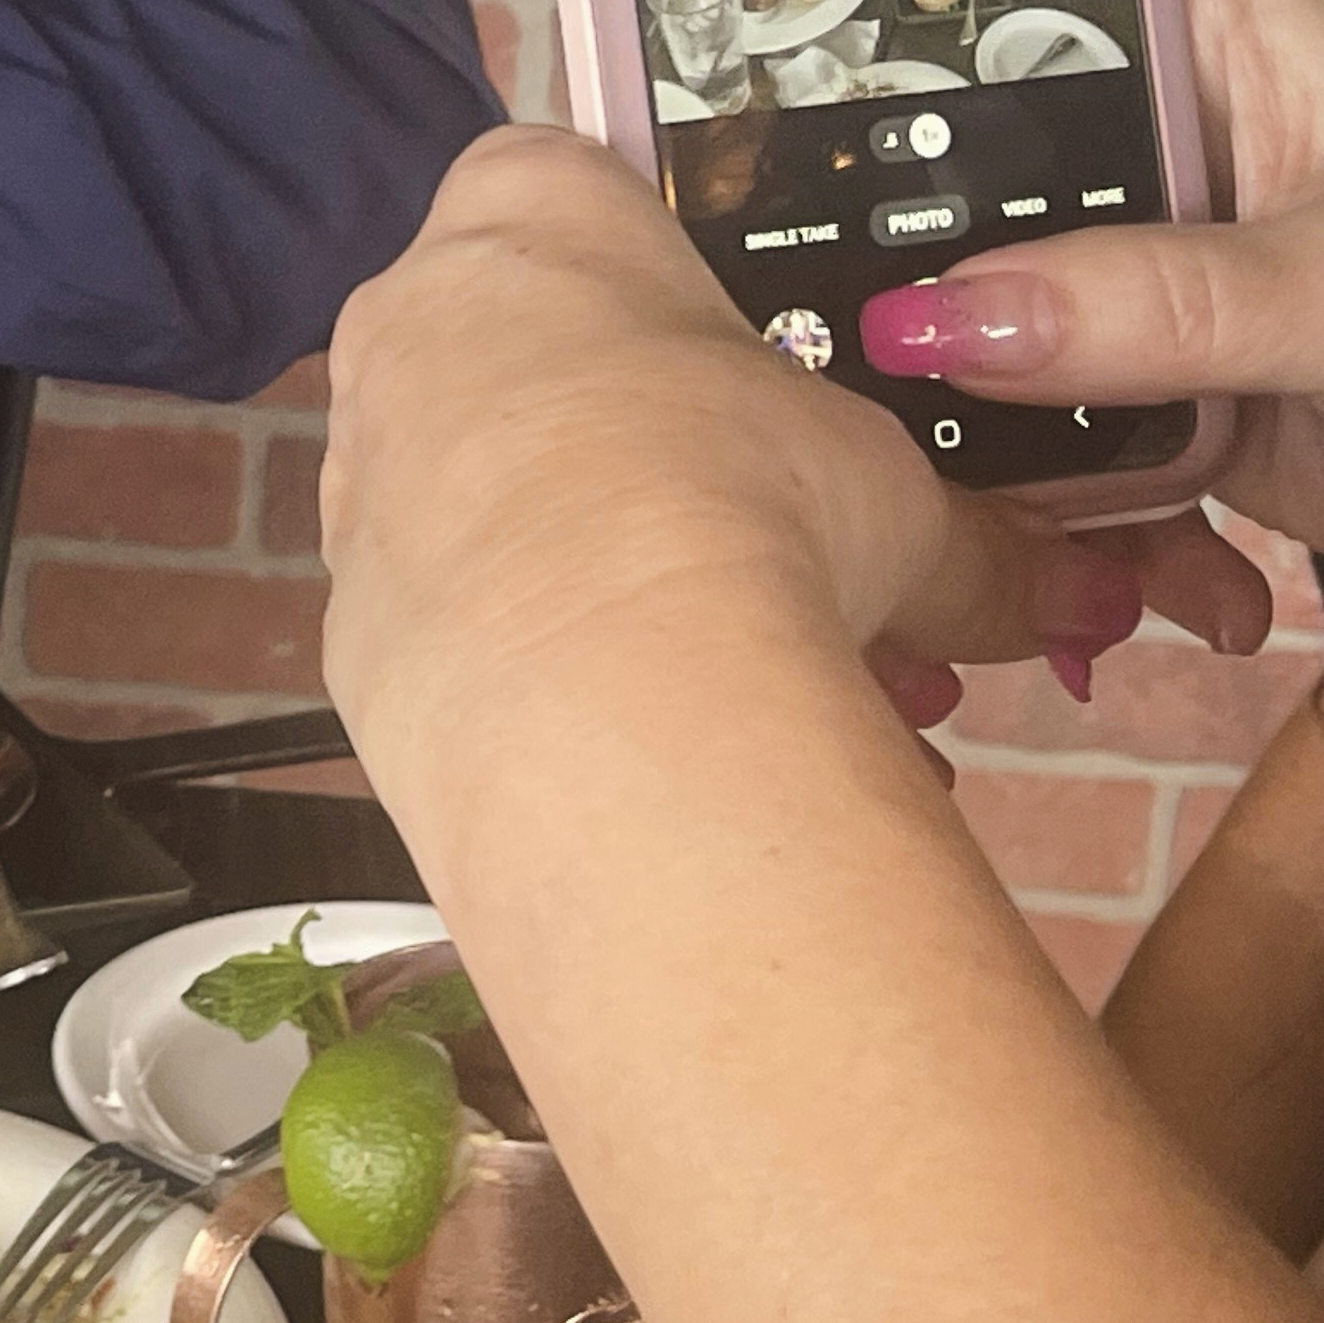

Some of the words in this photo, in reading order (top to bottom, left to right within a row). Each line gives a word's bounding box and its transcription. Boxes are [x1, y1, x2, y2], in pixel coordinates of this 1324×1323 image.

[1001, 197, 1048, 217] VIDEO
[1081, 186, 1126, 208] MORE
[887, 207, 954, 236] PHOTO
[799, 223, 840, 244] TAKE
